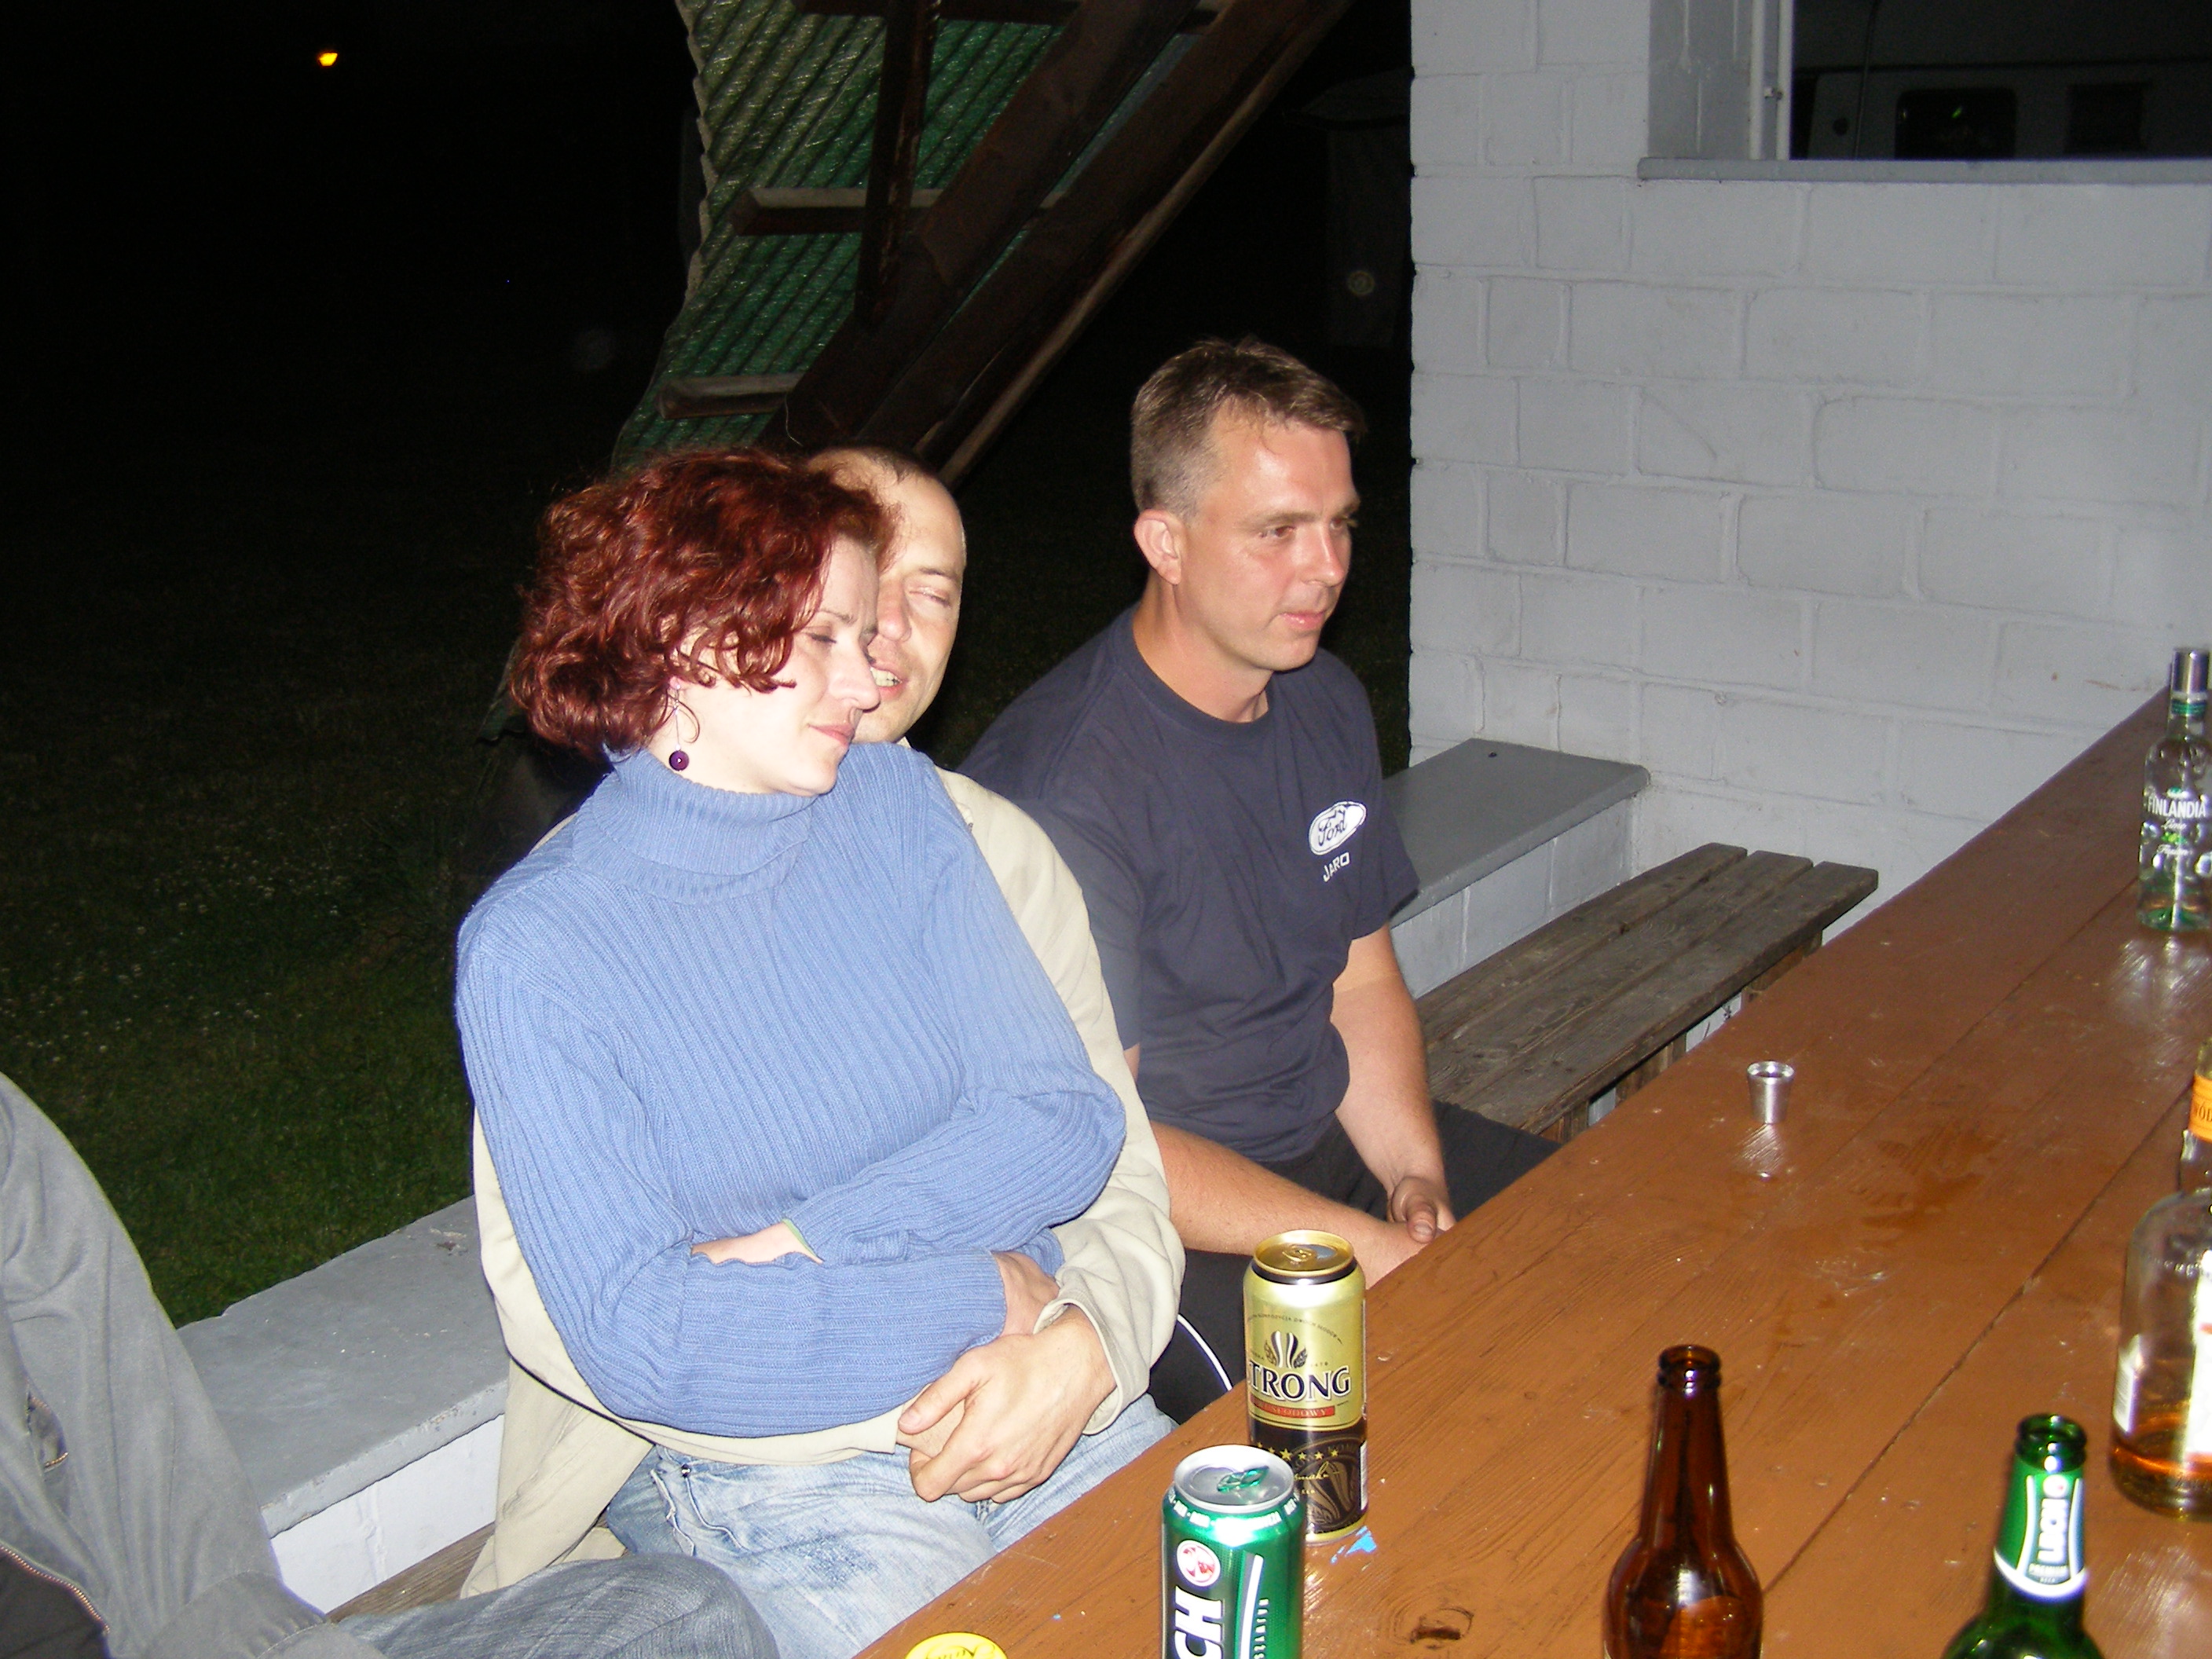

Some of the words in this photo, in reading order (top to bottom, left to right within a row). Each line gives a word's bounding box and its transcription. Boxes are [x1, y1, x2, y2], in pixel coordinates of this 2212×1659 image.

[2148, 797, 2206, 819] FINLANDIA
[1317, 808, 1348, 847] Ford
[1322, 852, 1350, 882] JARO
[1249, 1359, 1351, 1402] TRONG
